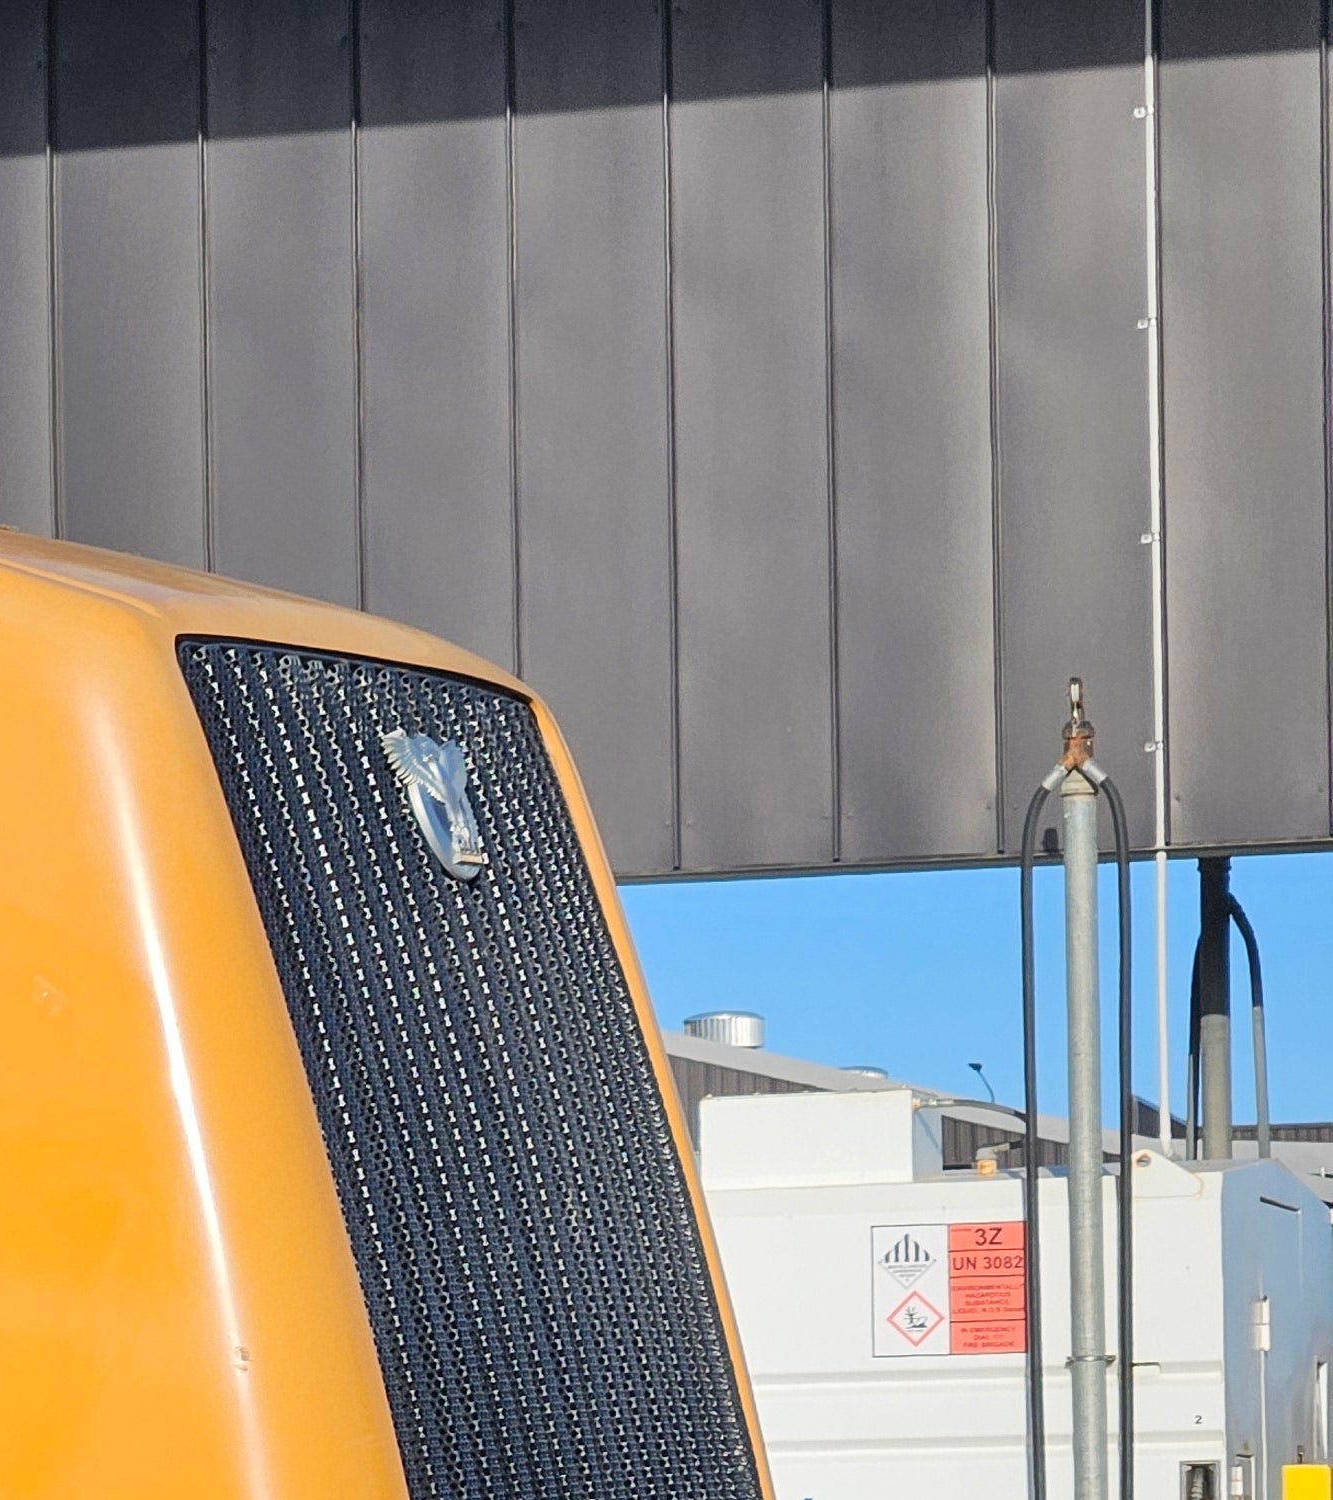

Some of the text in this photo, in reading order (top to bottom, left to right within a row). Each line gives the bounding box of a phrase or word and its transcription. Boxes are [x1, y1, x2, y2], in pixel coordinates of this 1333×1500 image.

[975, 1227, 1003, 1246] 3Z
[953, 1255, 1023, 1271] UN 3082
[1194, 1414, 1203, 1425] 2
